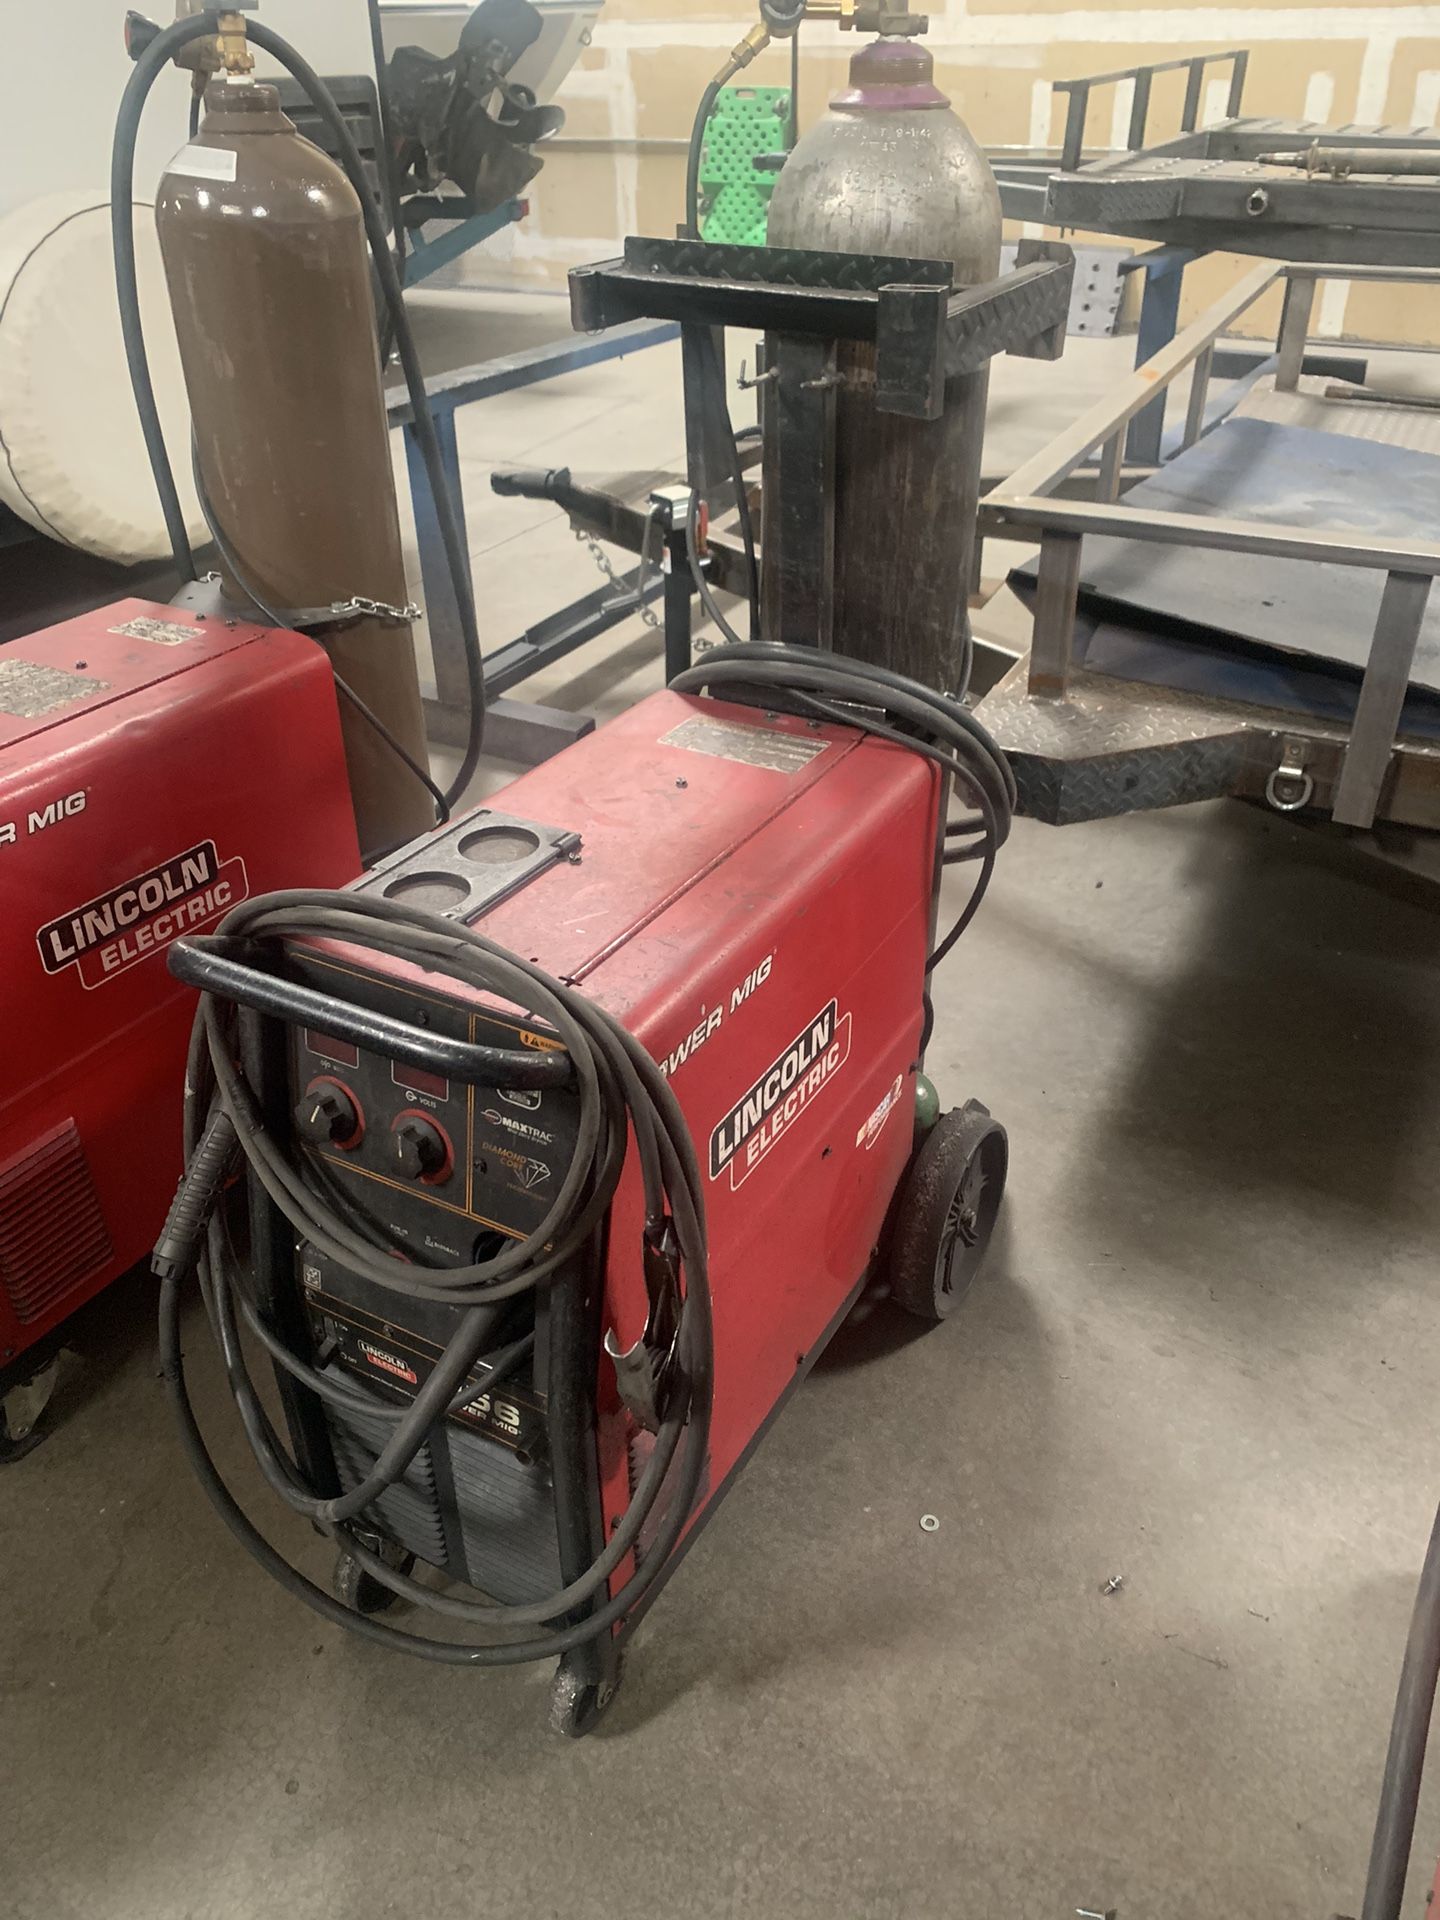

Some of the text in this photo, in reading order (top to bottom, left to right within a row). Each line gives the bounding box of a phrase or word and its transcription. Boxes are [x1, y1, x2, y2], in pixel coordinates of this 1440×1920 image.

[28, 790, 86, 834] MIG
[49, 851, 210, 962] LINCOLN
[99, 880, 232, 972] ELECTRIC
[658, 954, 773, 1077] OWER MIG
[718, 1012, 830, 1164] LINCOLN
[746, 1041, 840, 1168] ELECTRIC
[482, 1142, 527, 1164] DIAMOND
[502, 1117, 553, 1143] MAXTRAC
[361, 1342, 405, 1370] LINCOLN
[491, 1418, 519, 1436] MIG
